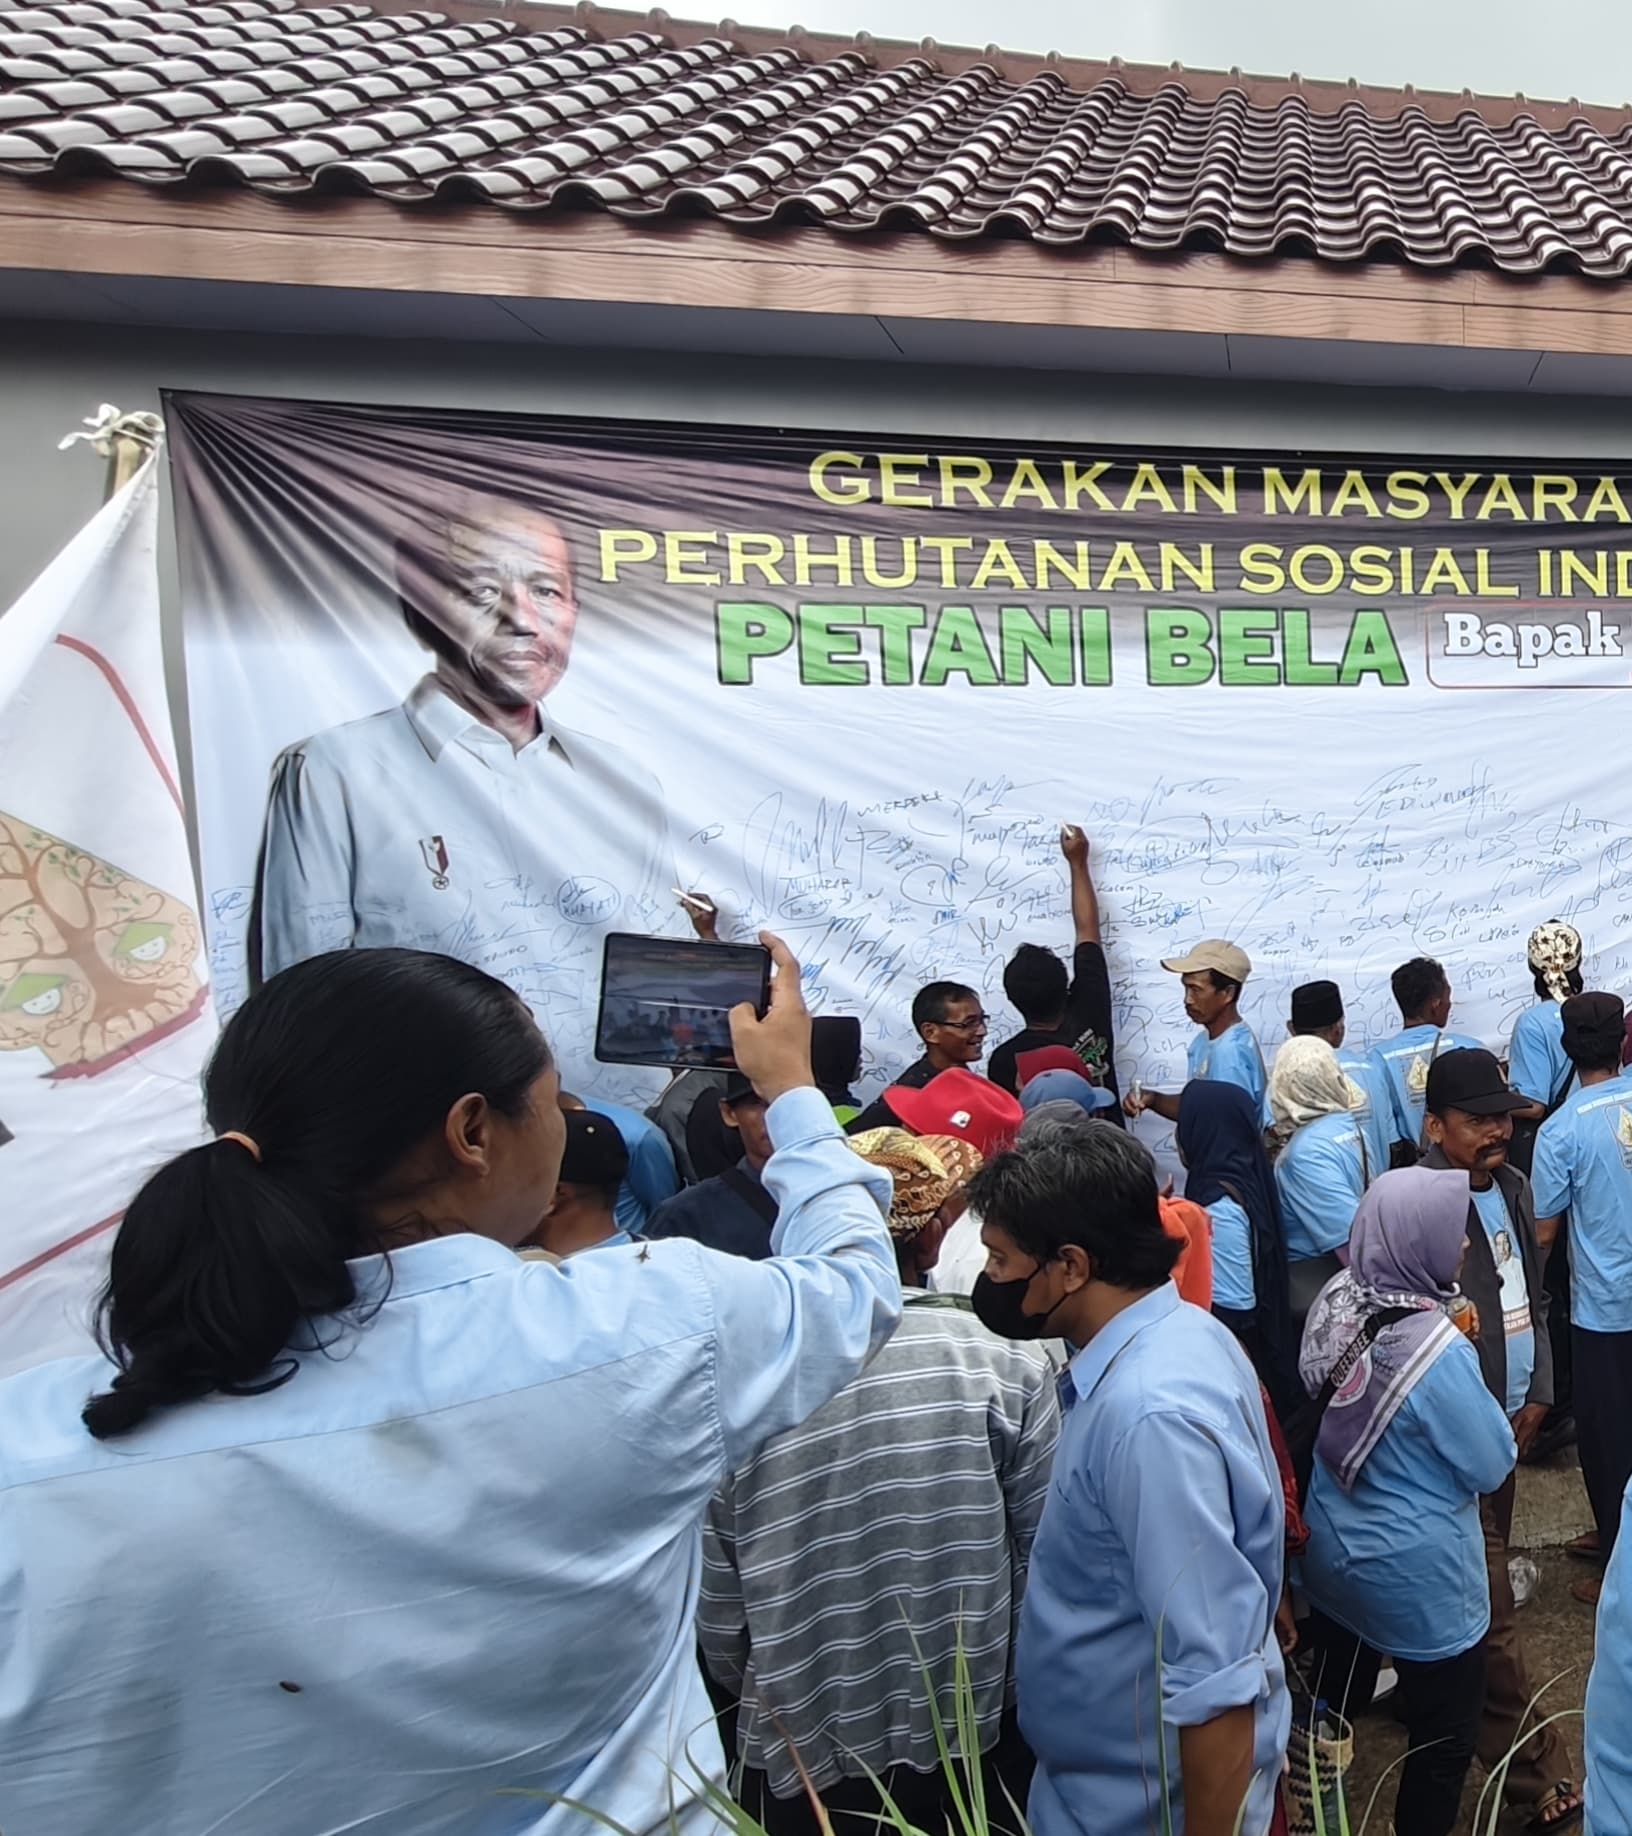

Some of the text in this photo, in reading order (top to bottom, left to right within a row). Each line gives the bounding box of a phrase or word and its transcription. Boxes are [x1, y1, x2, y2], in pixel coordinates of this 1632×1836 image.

[808, 450, 1239, 515] GERAKAN
[598, 529, 1215, 592] PERHUTANAN
[1237, 543, 1521, 597] SOSIAL
[714, 601, 1113, 687] PETANI
[1146, 606, 1410, 687] BELA
[1443, 611, 1624, 668] Bapak
[1331, 1330, 1370, 1388] QUEENBEE
